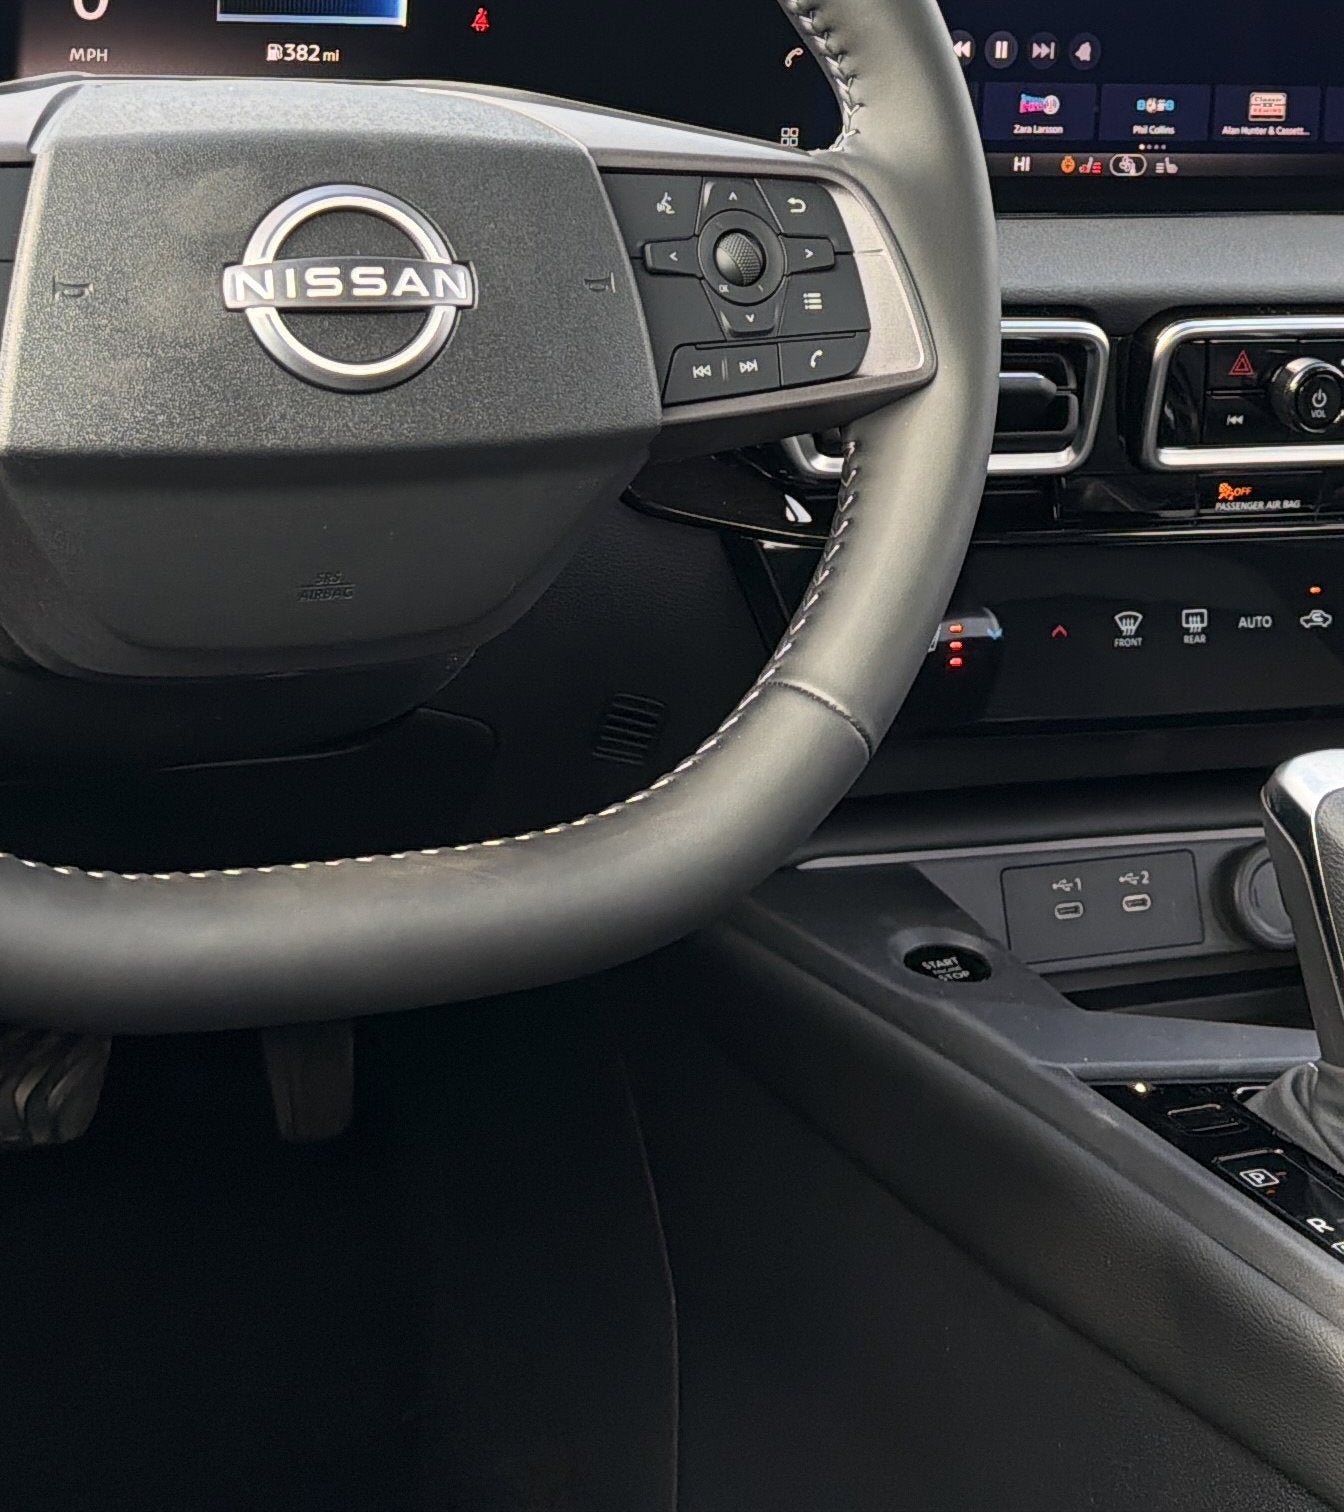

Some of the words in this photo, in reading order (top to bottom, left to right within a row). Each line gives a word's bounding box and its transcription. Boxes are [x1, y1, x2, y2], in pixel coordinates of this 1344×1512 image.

[69, 46, 108, 63] MPH
[284, 44, 320, 61] 382
[322, 48, 340, 62] mi
[1013, 157, 1030, 172] HI
[232, 265, 467, 301] NISSAN
[1311, 409, 1326, 418] VOL
[1233, 487, 1253, 497] OFF
[1215, 501, 1265, 511] PASSENGER
[1266, 500, 1282, 509] AIR
[1282, 499, 1302, 508] BAG
[297, 588, 354, 601] AIRBAG
[1238, 616, 1272, 629] AUTO
[1114, 638, 1143, 648] FRONT
[1183, 635, 1206, 644] REAR
[1140, 870, 1150, 884] 2
[1074, 877, 1082, 891] 1
[921, 956, 959, 970] START
[938, 970, 970, 982] STOP
[1249, 1172, 1264, 1184] P
[1306, 1218, 1335, 1233] R
